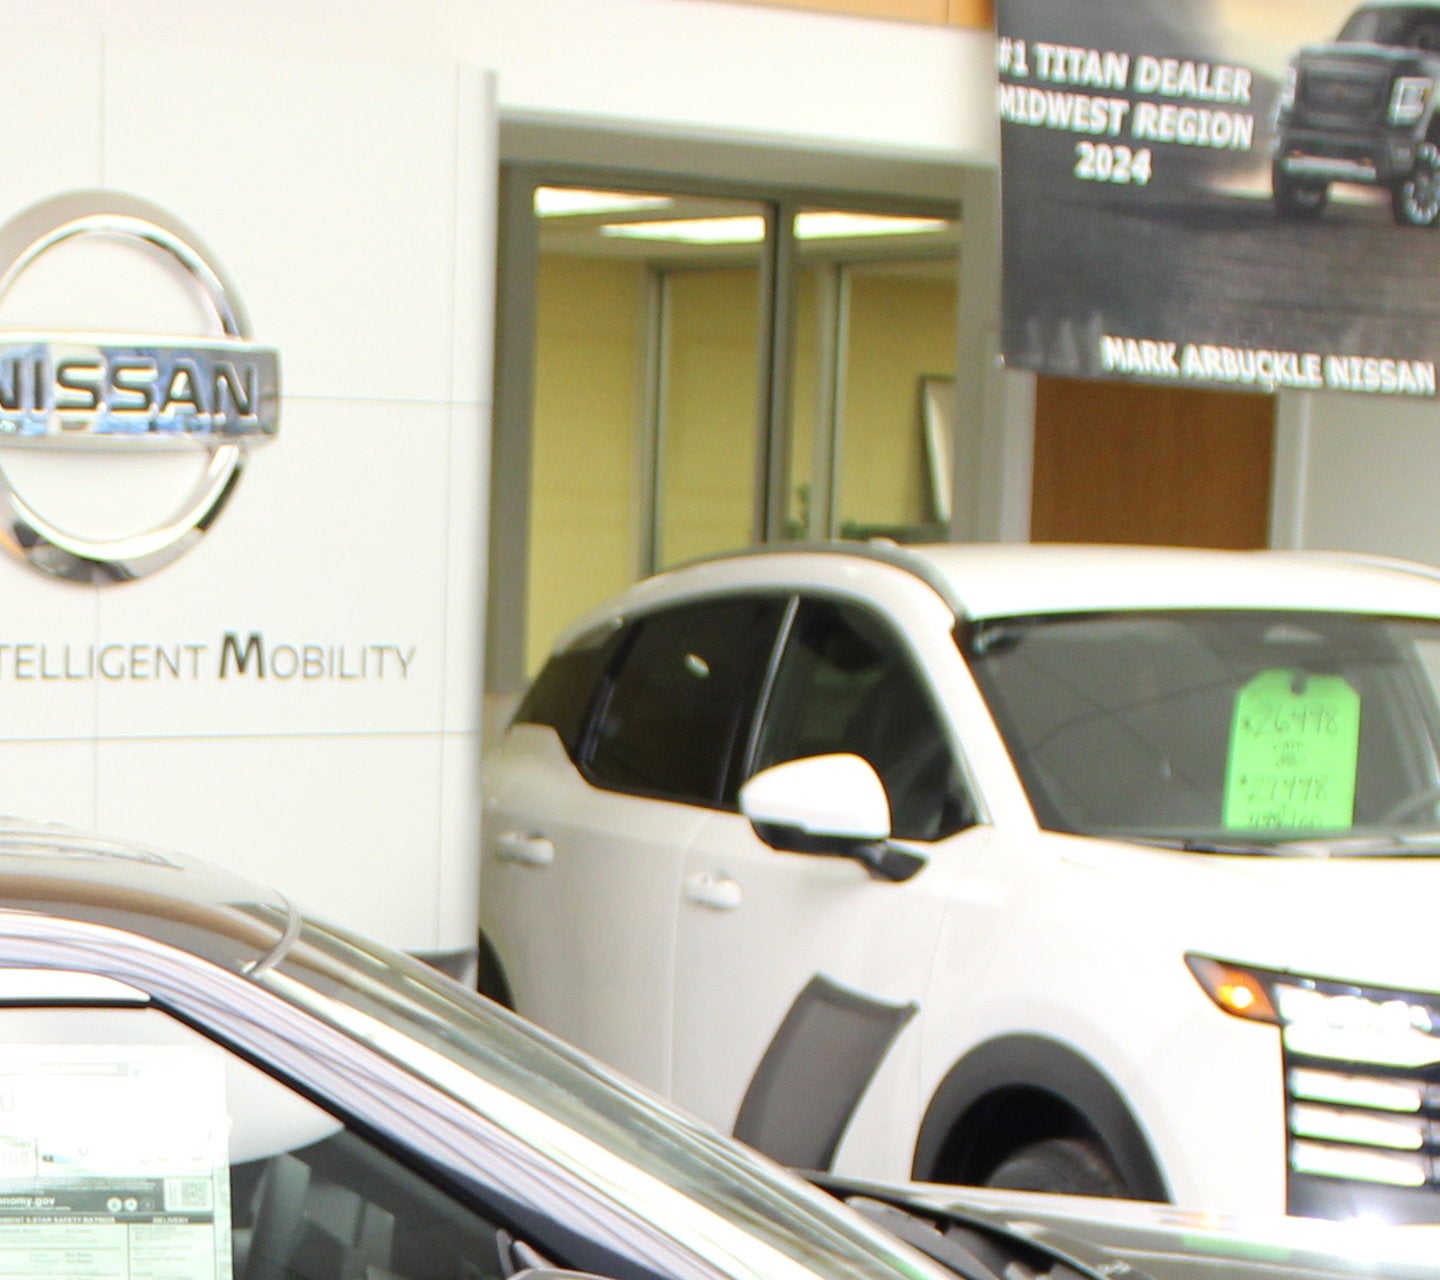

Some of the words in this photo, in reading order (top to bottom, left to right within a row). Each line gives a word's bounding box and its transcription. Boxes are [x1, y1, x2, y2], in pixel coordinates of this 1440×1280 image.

[997, 37, 1028, 77] #1
[1034, 42, 1129, 90] TITAN
[1134, 54, 1253, 102] DEALER
[999, 85, 1130, 138] MIDWEST
[1132, 102, 1255, 150] REGION
[1074, 142, 1153, 186] 2024
[1100, 336, 1180, 377] MARK
[1181, 345, 1322, 387] ARBUCKLE
[1327, 354, 1437, 396] NISSAN
[219, 631, 418, 681] MOBILITY
